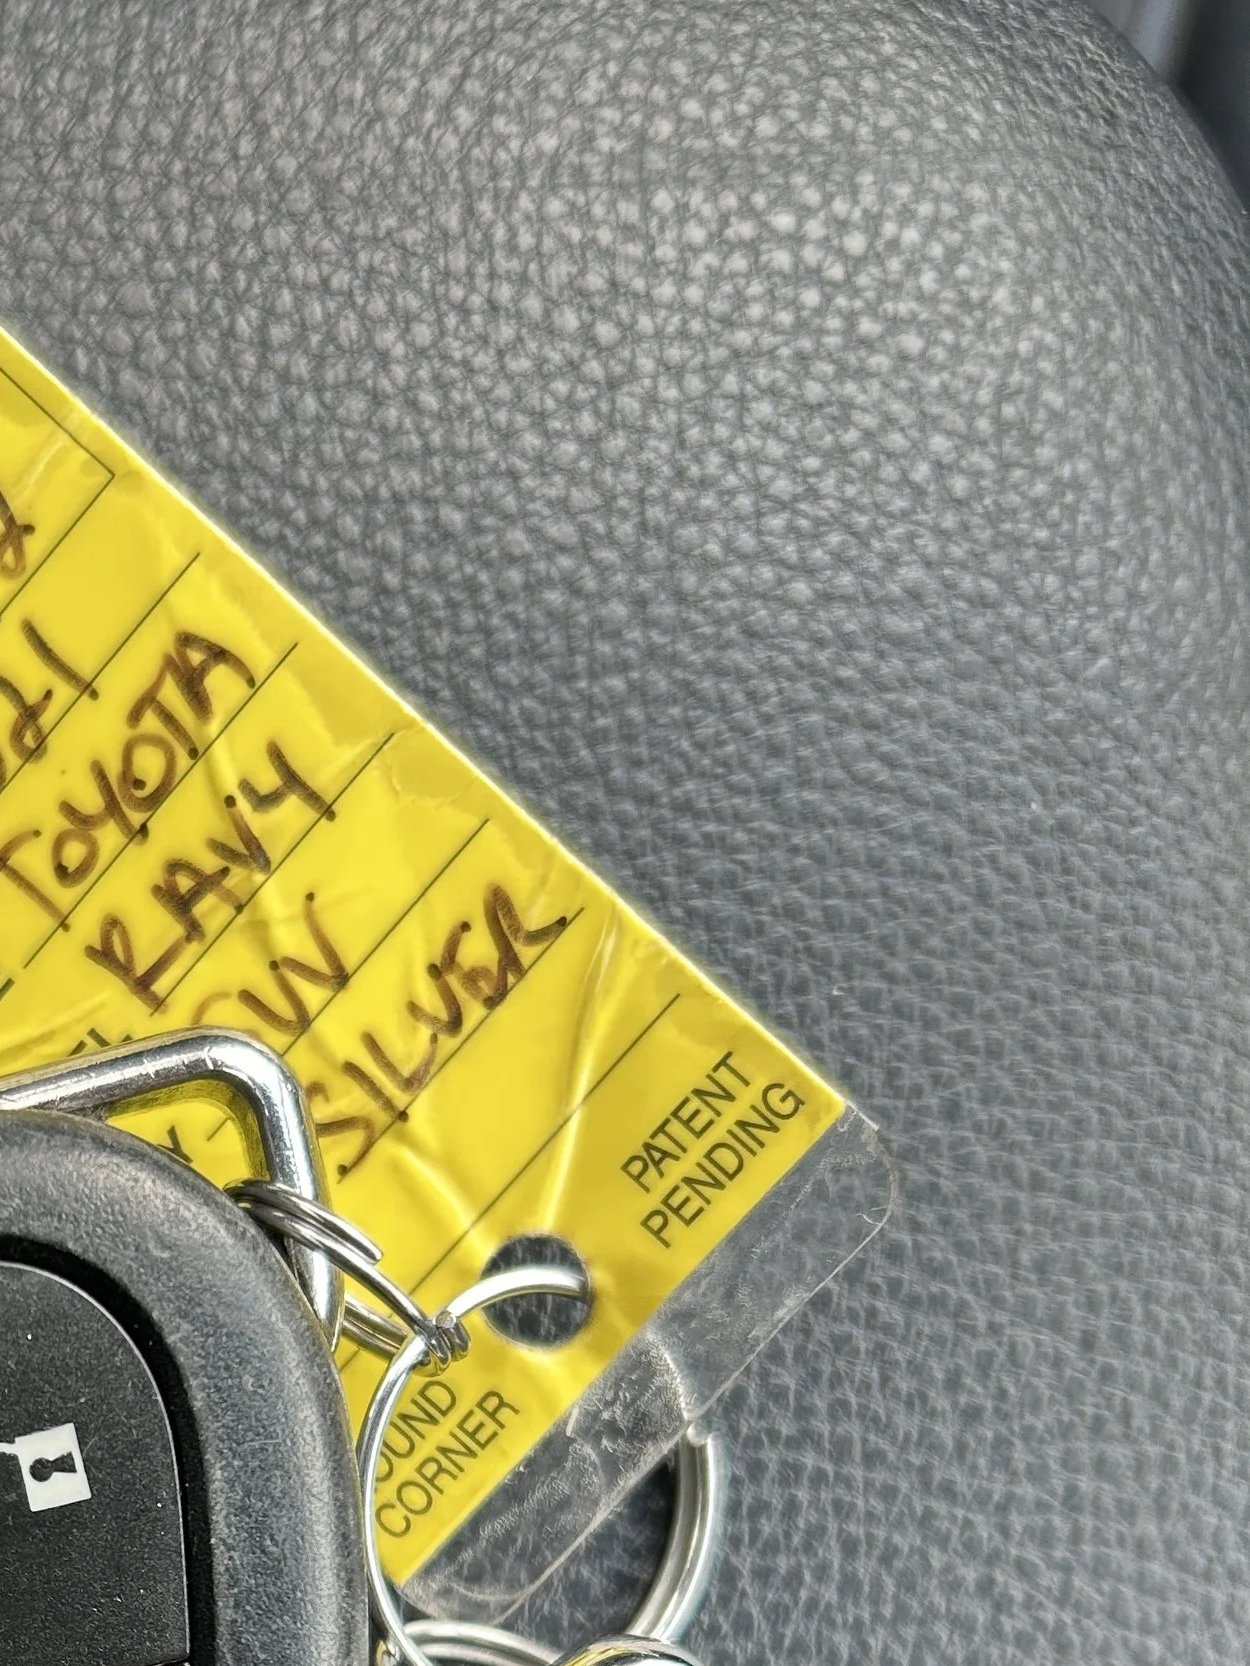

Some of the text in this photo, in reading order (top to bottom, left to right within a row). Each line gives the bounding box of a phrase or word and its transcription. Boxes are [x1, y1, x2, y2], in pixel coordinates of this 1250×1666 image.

[620, 1050, 751, 1194] PATENT
[639, 1082, 806, 1249] PENDING
[374, 1380, 457, 1492] OUND
[374, 1390, 521, 1538] CORNER
